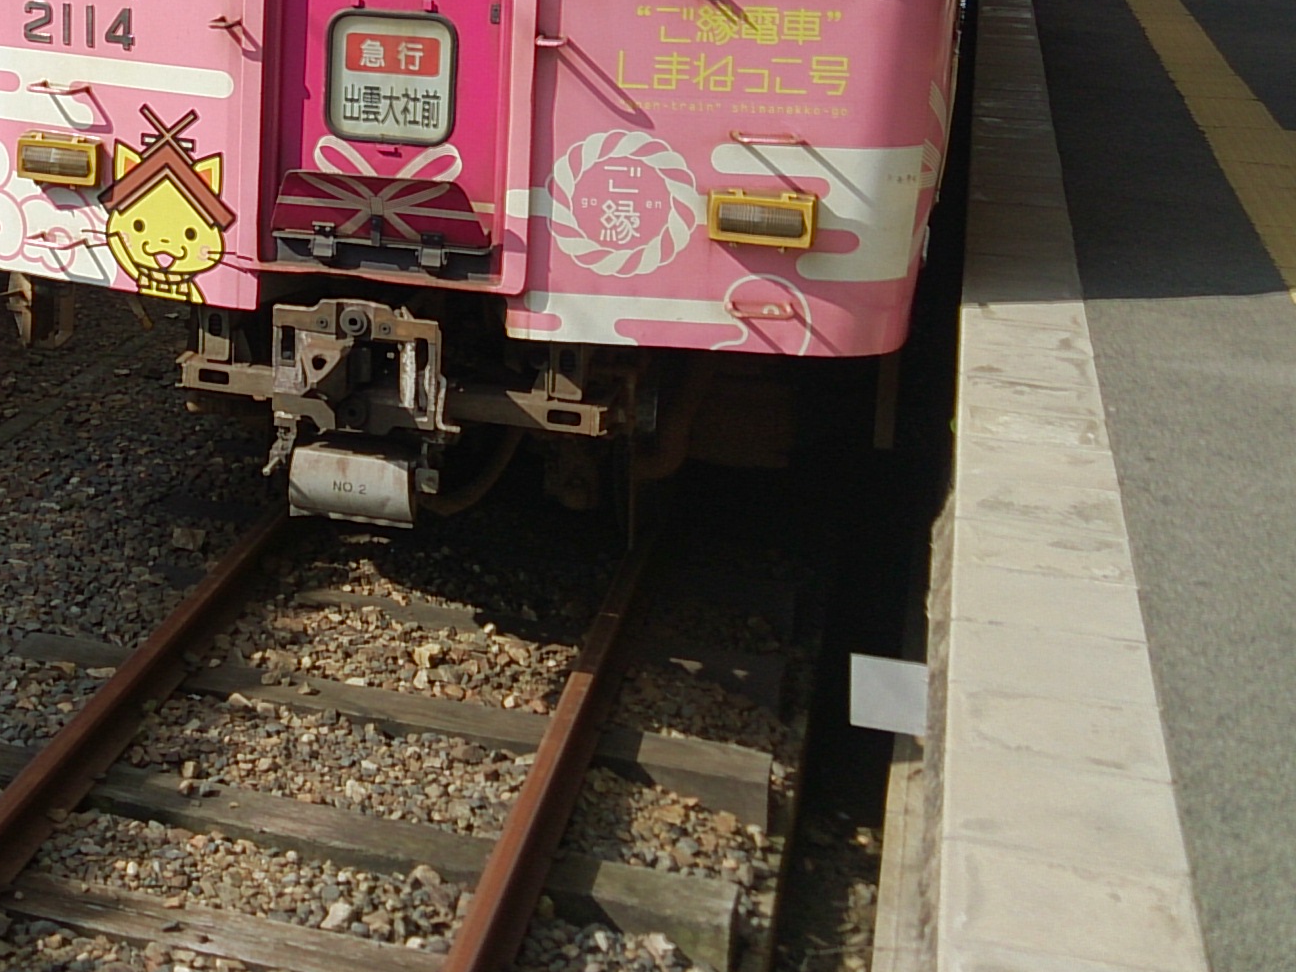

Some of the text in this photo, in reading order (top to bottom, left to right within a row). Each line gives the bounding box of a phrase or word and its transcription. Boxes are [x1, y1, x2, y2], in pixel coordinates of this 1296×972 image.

[24, 0, 136, 52] 2114
[359, 38, 424, 71] 急行
[618, 49, 850, 96] しまねっこ号
[342, 83, 441, 129] 出雲大社前
[600, 165, 642, 244] ご縁
[645, 200, 662, 209] en
[358, 484, 367, 495] 2
